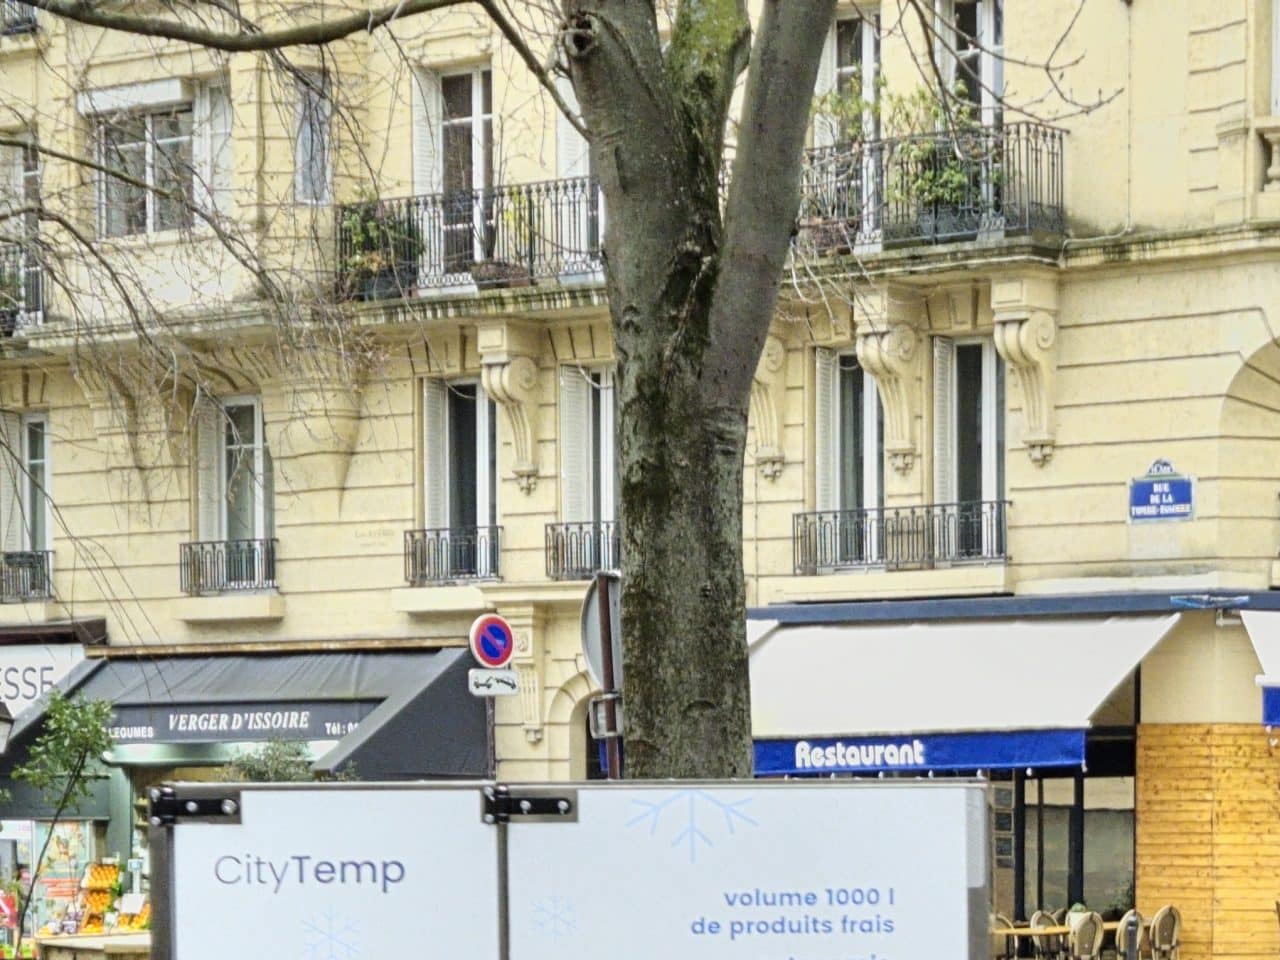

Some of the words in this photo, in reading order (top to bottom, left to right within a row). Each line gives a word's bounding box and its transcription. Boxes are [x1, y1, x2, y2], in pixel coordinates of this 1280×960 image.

[1162, 493, 1173, 504] LA
[0, 666, 54, 700] SSE
[169, 713, 229, 731] VERGER
[231, 711, 310, 730] D'ISSOIRE
[795, 739, 925, 769] Restaurant
[215, 853, 405, 894] CityTemp
[724, 888, 817, 906] volume
[825, 888, 880, 905] 1000
[690, 917, 721, 935] de
[730, 915, 833, 940] produits
[841, 914, 895, 934] frais
